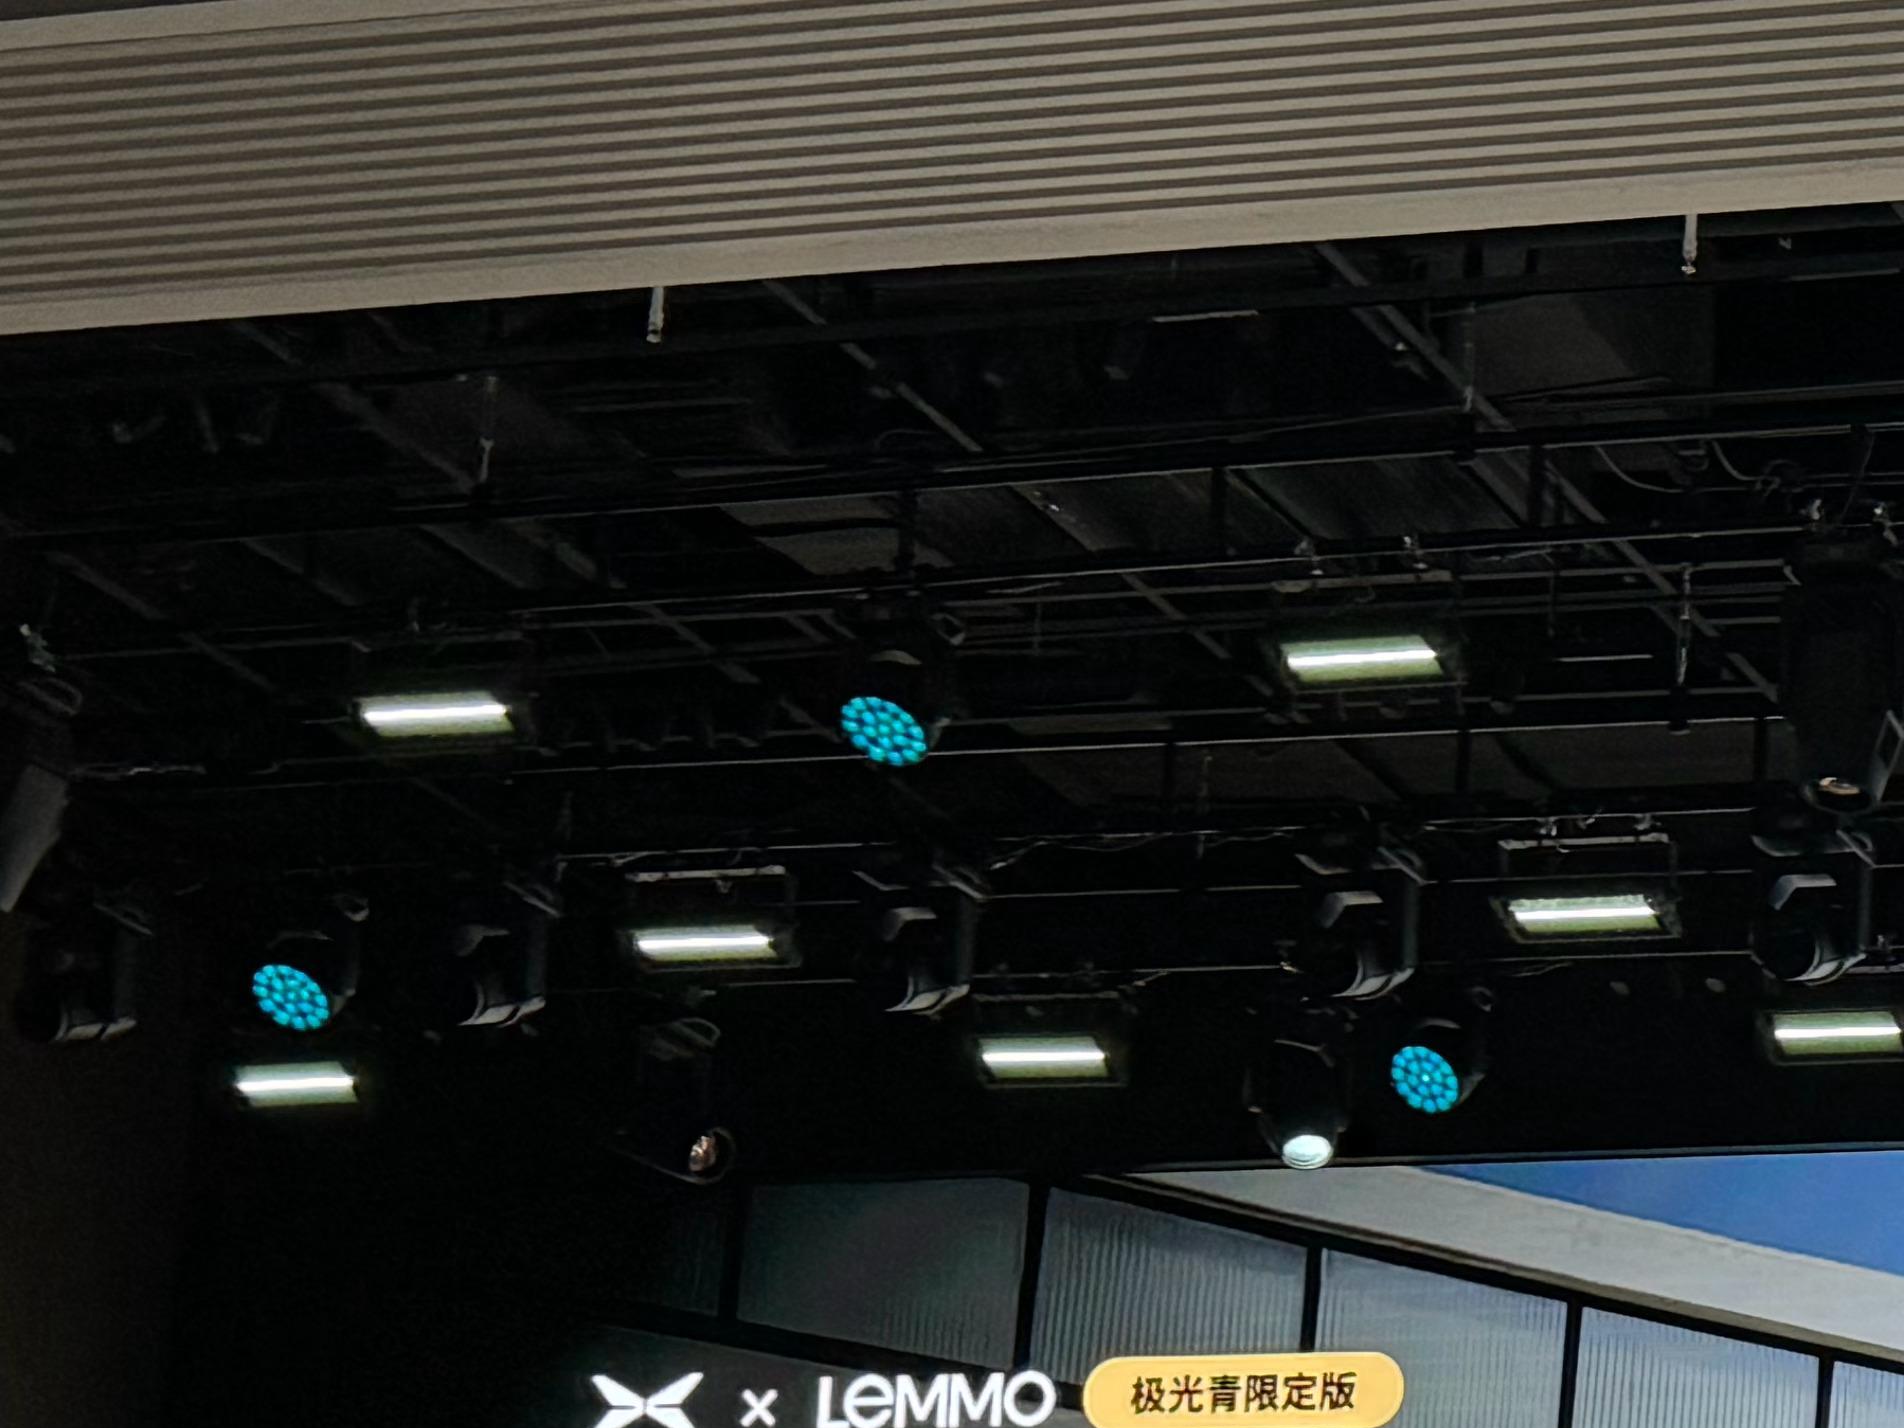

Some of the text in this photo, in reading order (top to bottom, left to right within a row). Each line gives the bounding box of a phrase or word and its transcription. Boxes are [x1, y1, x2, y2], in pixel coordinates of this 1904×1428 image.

[1130, 1369, 1357, 1415] 极光青限定版
